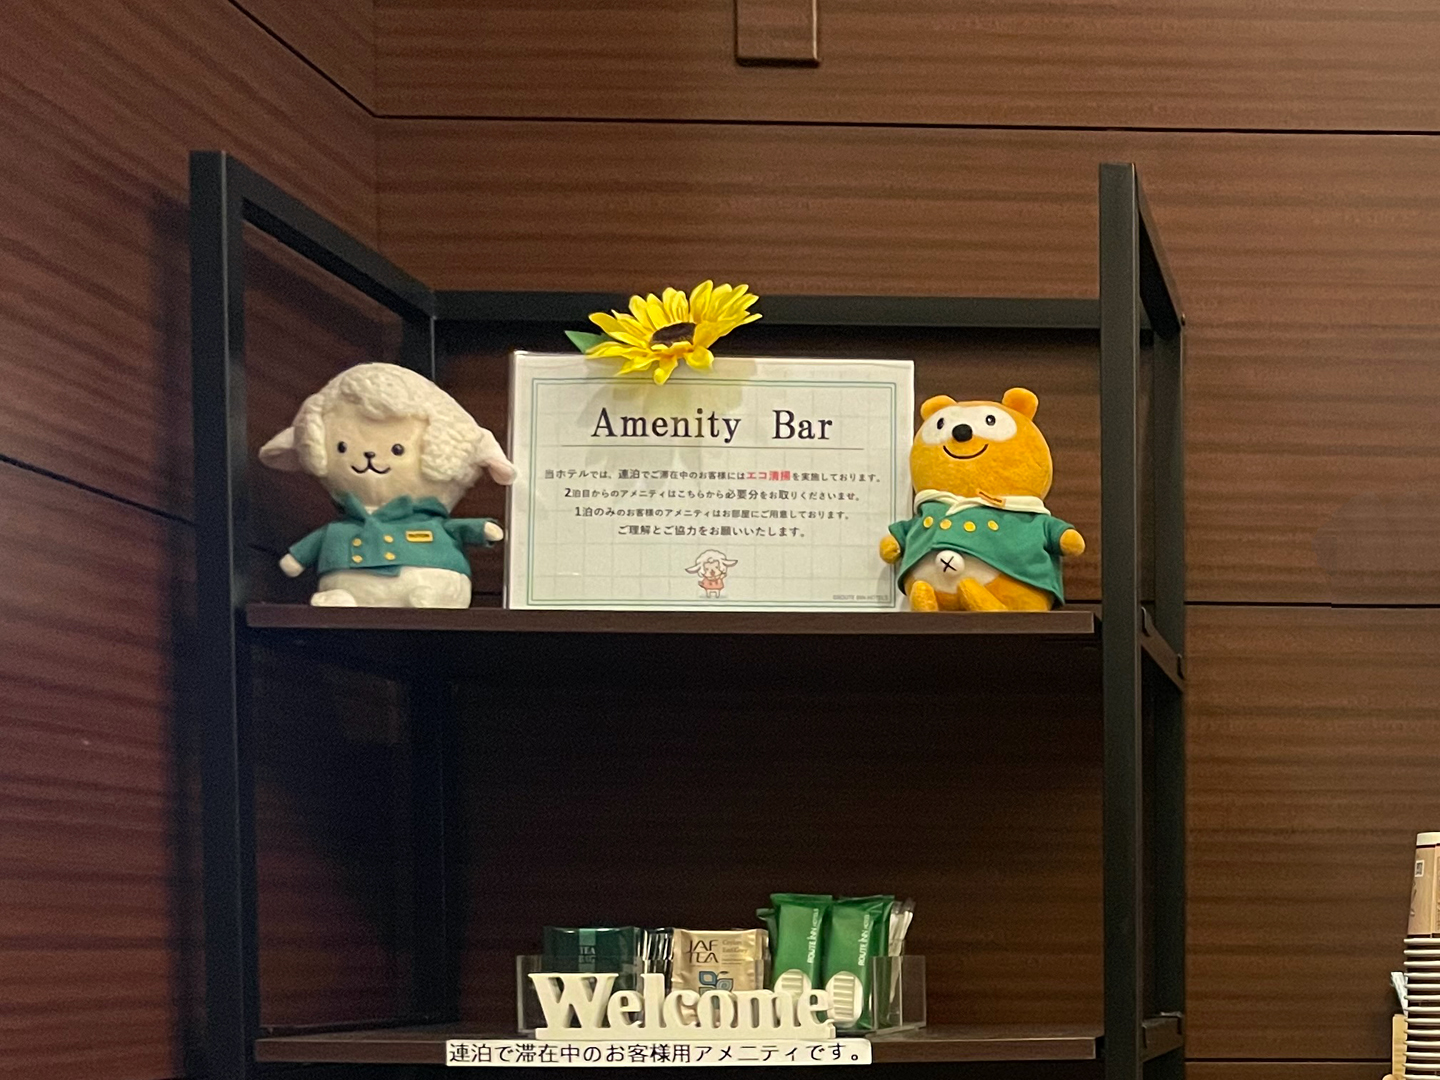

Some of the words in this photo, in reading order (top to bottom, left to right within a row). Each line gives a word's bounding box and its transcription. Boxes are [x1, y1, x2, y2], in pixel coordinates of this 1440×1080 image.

[590, 406, 742, 443] Amenity
[771, 409, 833, 441] Bar
[689, 939, 719, 952] JAF
[528, 972, 835, 1030] Welcome
[449, 1042, 861, 1065] 連泊で滞在中のお客様用アメニティです。
